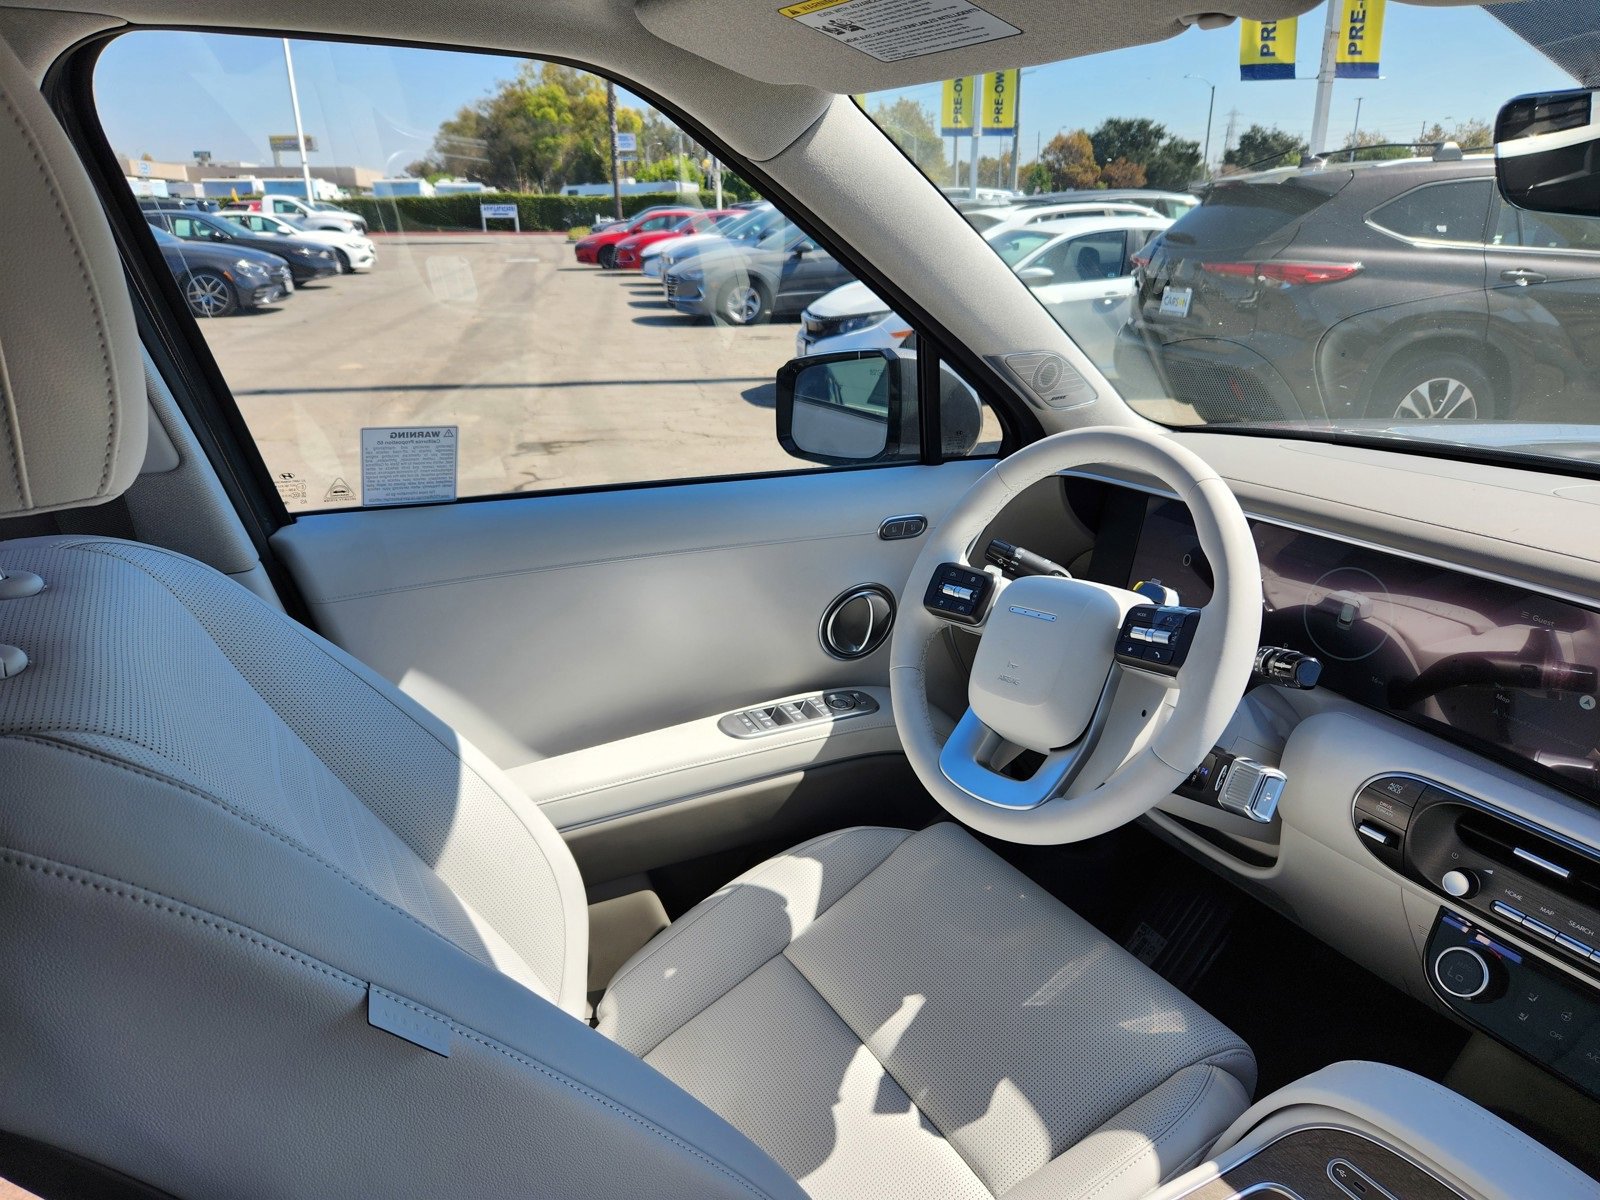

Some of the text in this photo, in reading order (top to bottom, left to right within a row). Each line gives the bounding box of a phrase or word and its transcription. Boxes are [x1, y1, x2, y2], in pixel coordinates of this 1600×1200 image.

[1348, 0, 1367, 56] PRE-
[1260, 21, 1277, 57] PR
[1532, 614, 1556, 628] Guest
[1495, 693, 1511, 705] Map
[1504, 888, 1524, 902] HOME
[1539, 906, 1556, 917] MAP
[1567, 920, 1596, 937] SEARCH
